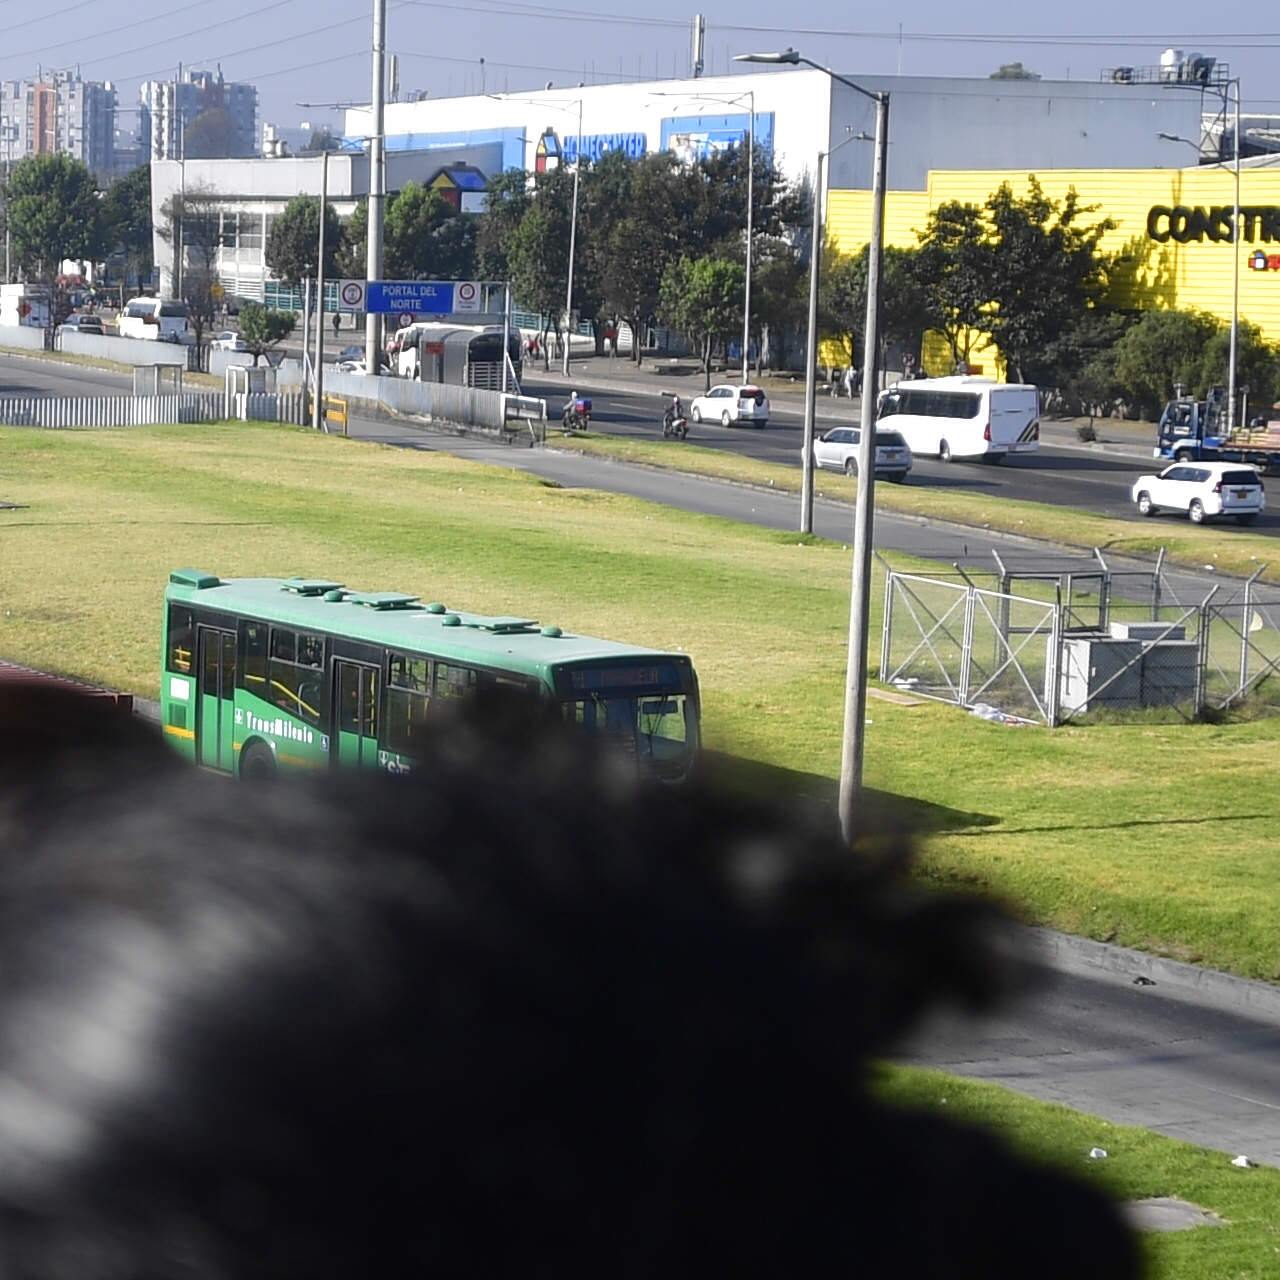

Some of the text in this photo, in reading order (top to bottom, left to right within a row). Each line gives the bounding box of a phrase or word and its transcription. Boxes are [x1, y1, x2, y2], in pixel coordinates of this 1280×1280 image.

[382, 285, 438, 297] PORTAL DEL
[391, 299, 422, 310] NORTE
[246, 710, 313, 744] TransMilenio
